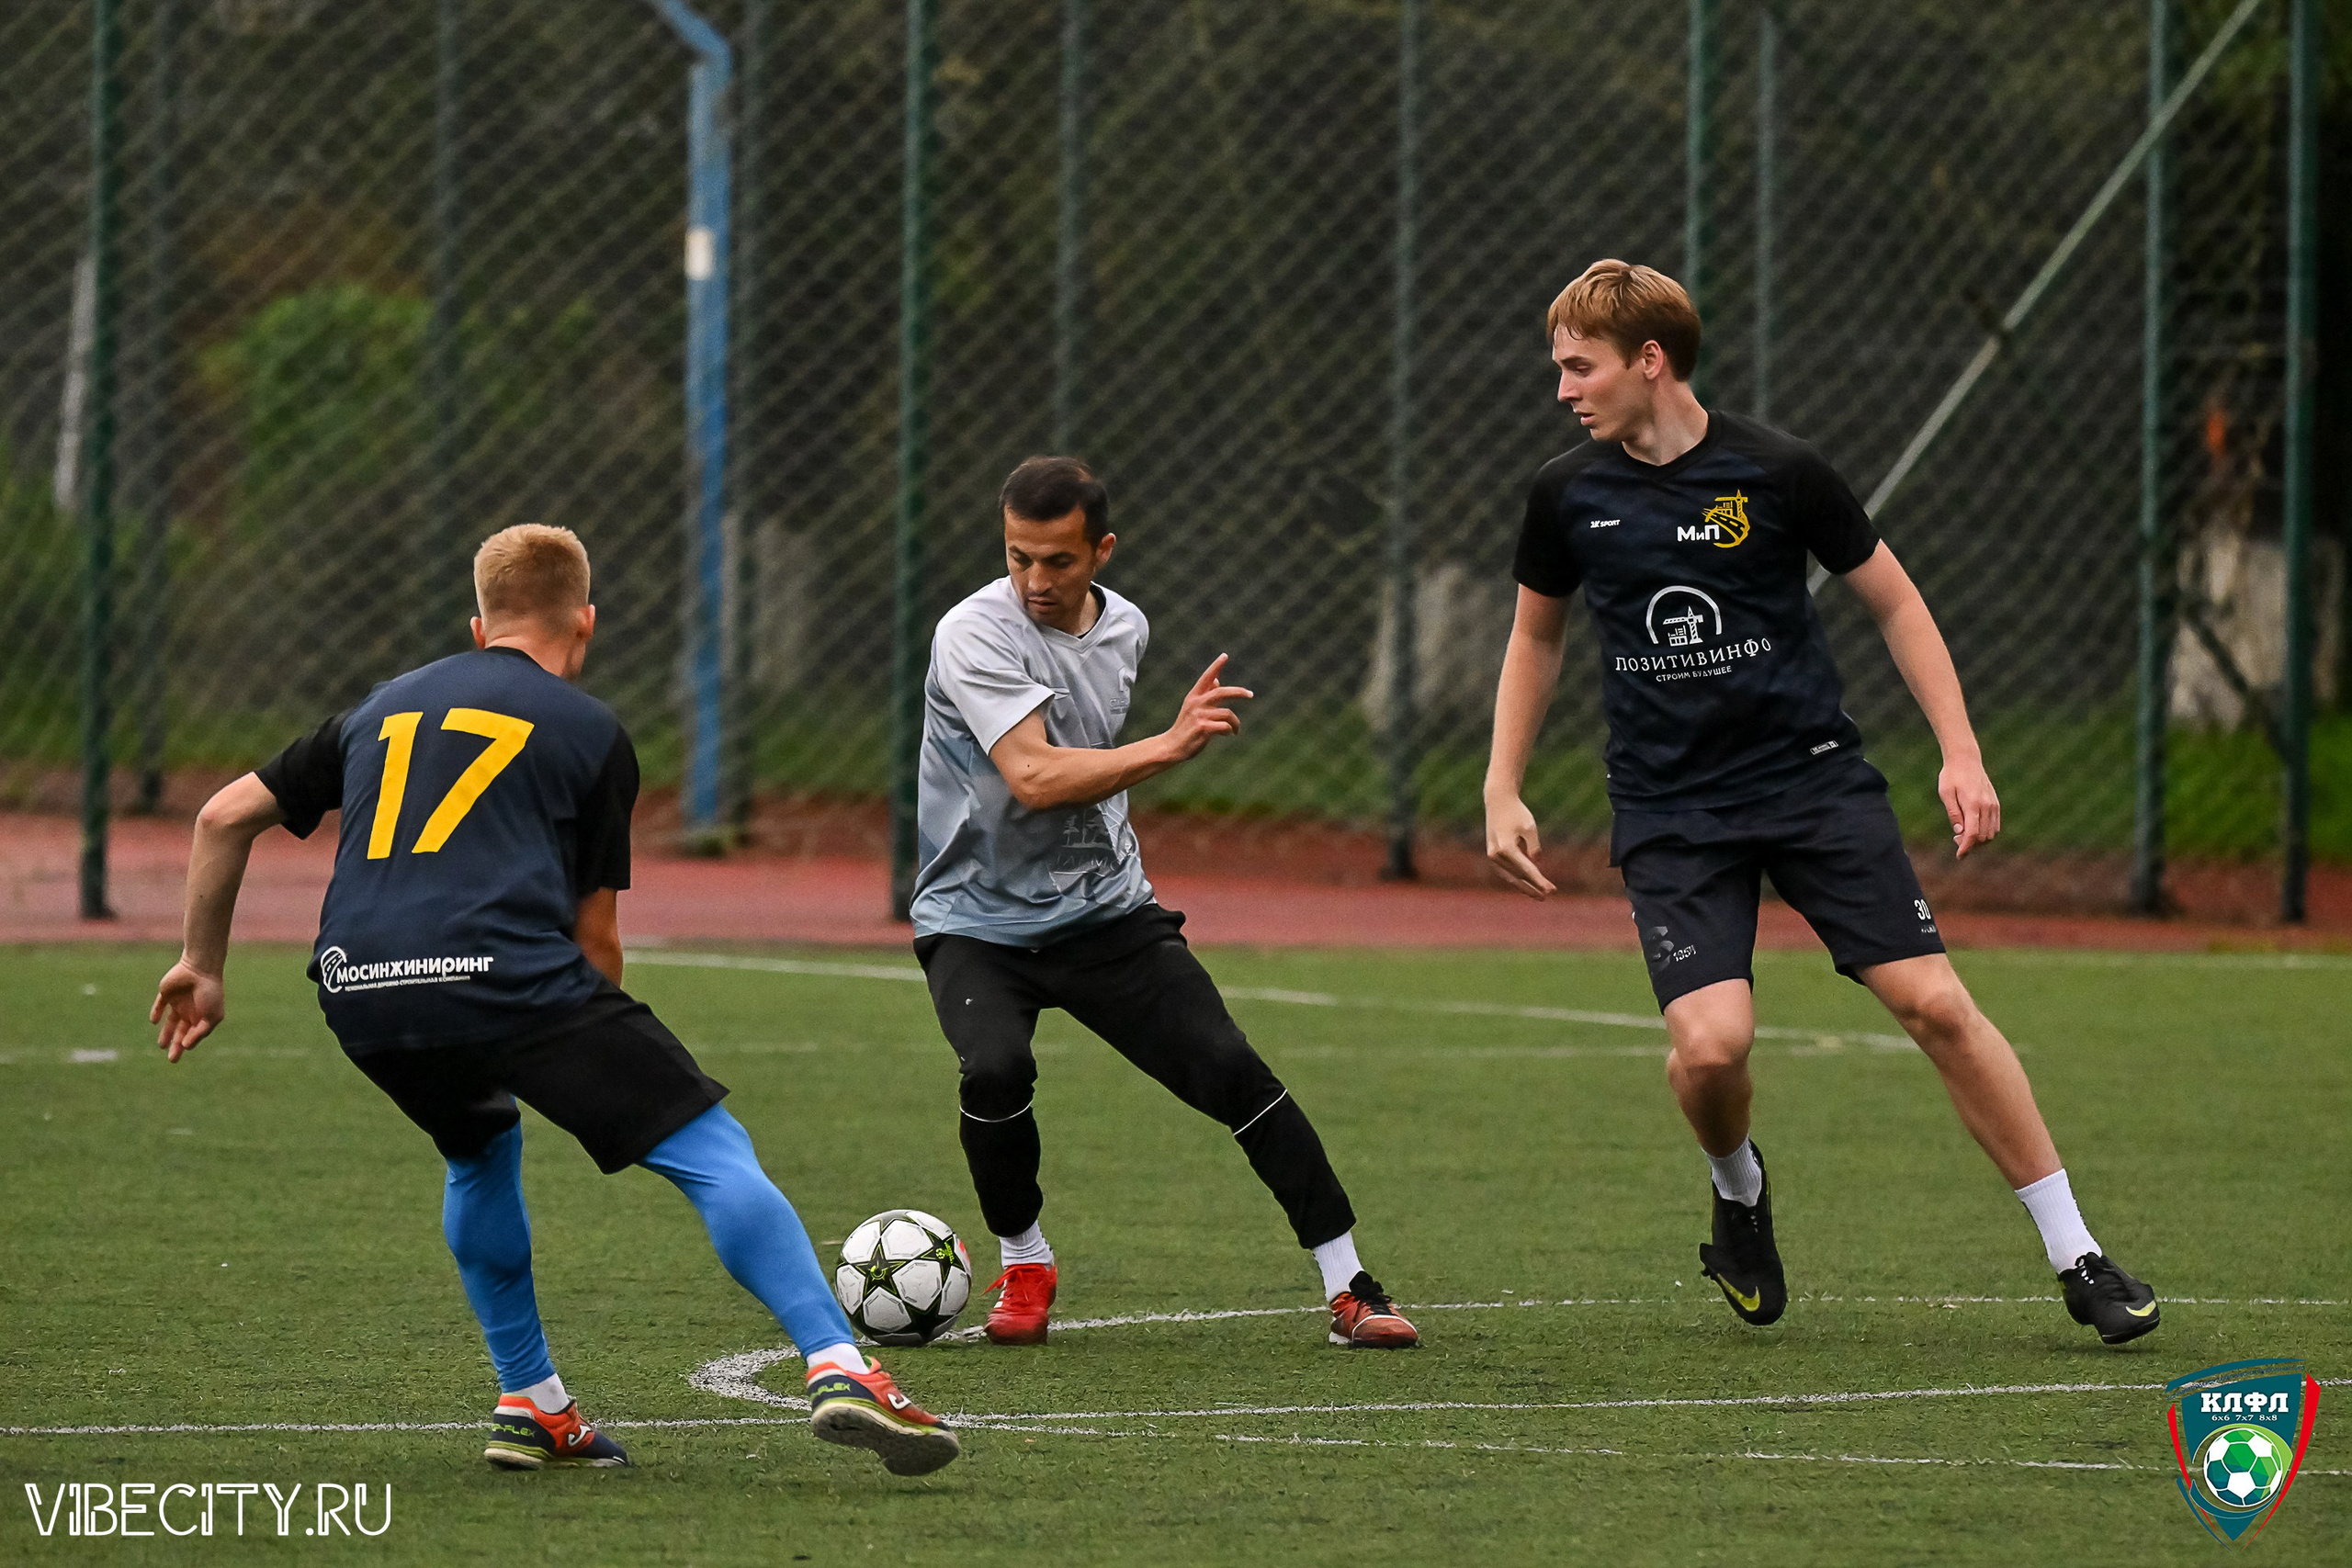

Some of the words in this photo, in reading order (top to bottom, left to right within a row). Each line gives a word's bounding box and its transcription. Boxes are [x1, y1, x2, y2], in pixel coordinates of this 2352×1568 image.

[1600, 519, 1621, 527] SPORT
[1677, 525, 1720, 542] МиП
[1615, 637, 1771, 671] ПОЗИТИВИНФО
[1656, 671, 1690, 682] СТРОИМ
[367, 707, 536, 860] 17
[1914, 898, 1932, 920] 30
